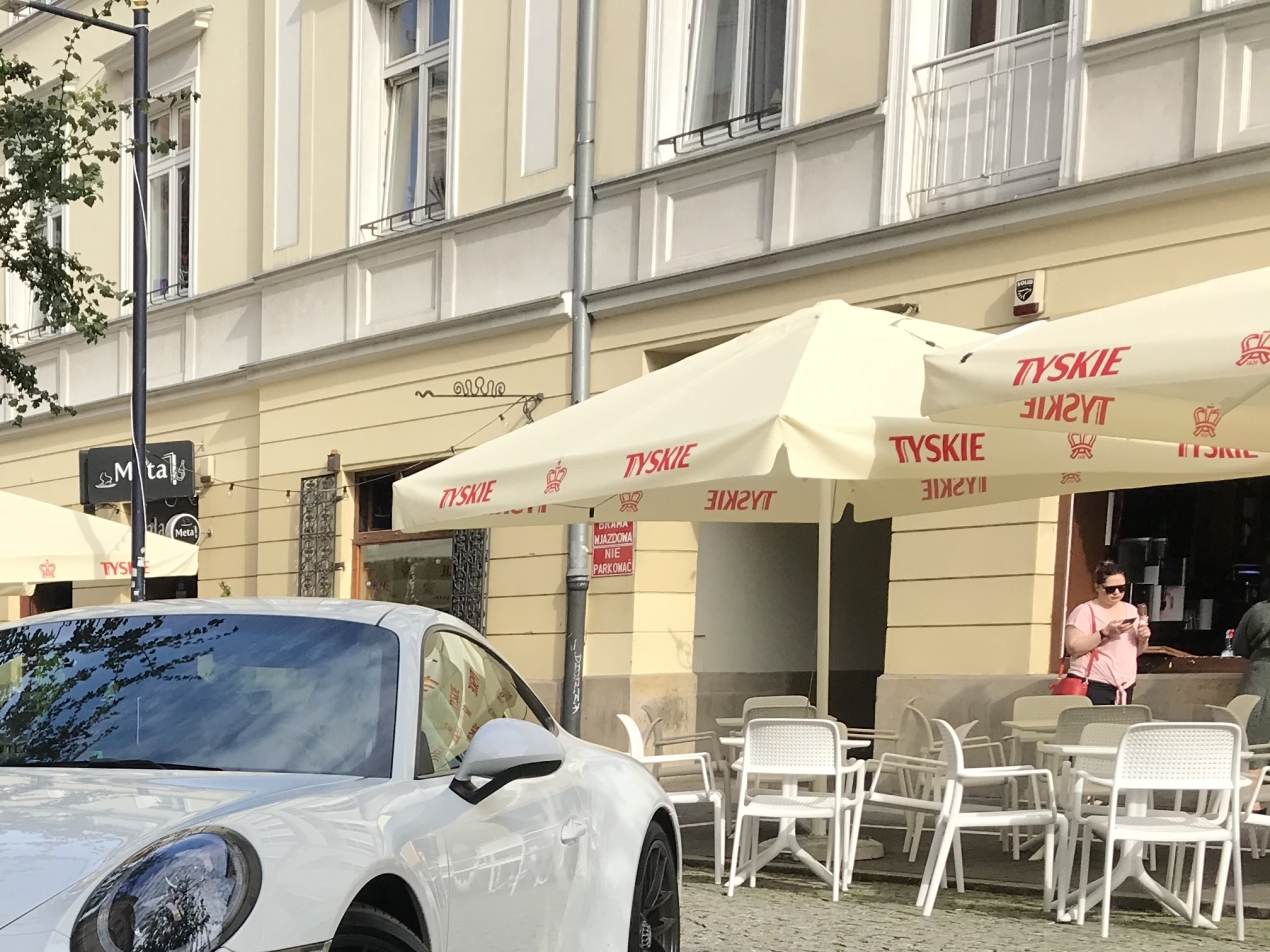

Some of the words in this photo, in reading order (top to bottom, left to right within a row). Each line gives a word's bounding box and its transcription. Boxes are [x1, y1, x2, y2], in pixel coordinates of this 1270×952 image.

[1012, 346, 1132, 386] TYSKIE
[623, 443, 698, 478] TYSKIE
[888, 432, 985, 463] TYSKIE
[438, 480, 497, 509] TYSKIE
[594, 532, 633, 545] WJAZDOWA
[593, 559, 632, 574] PARKOWAĆ
[605, 548, 620, 559] NIE
